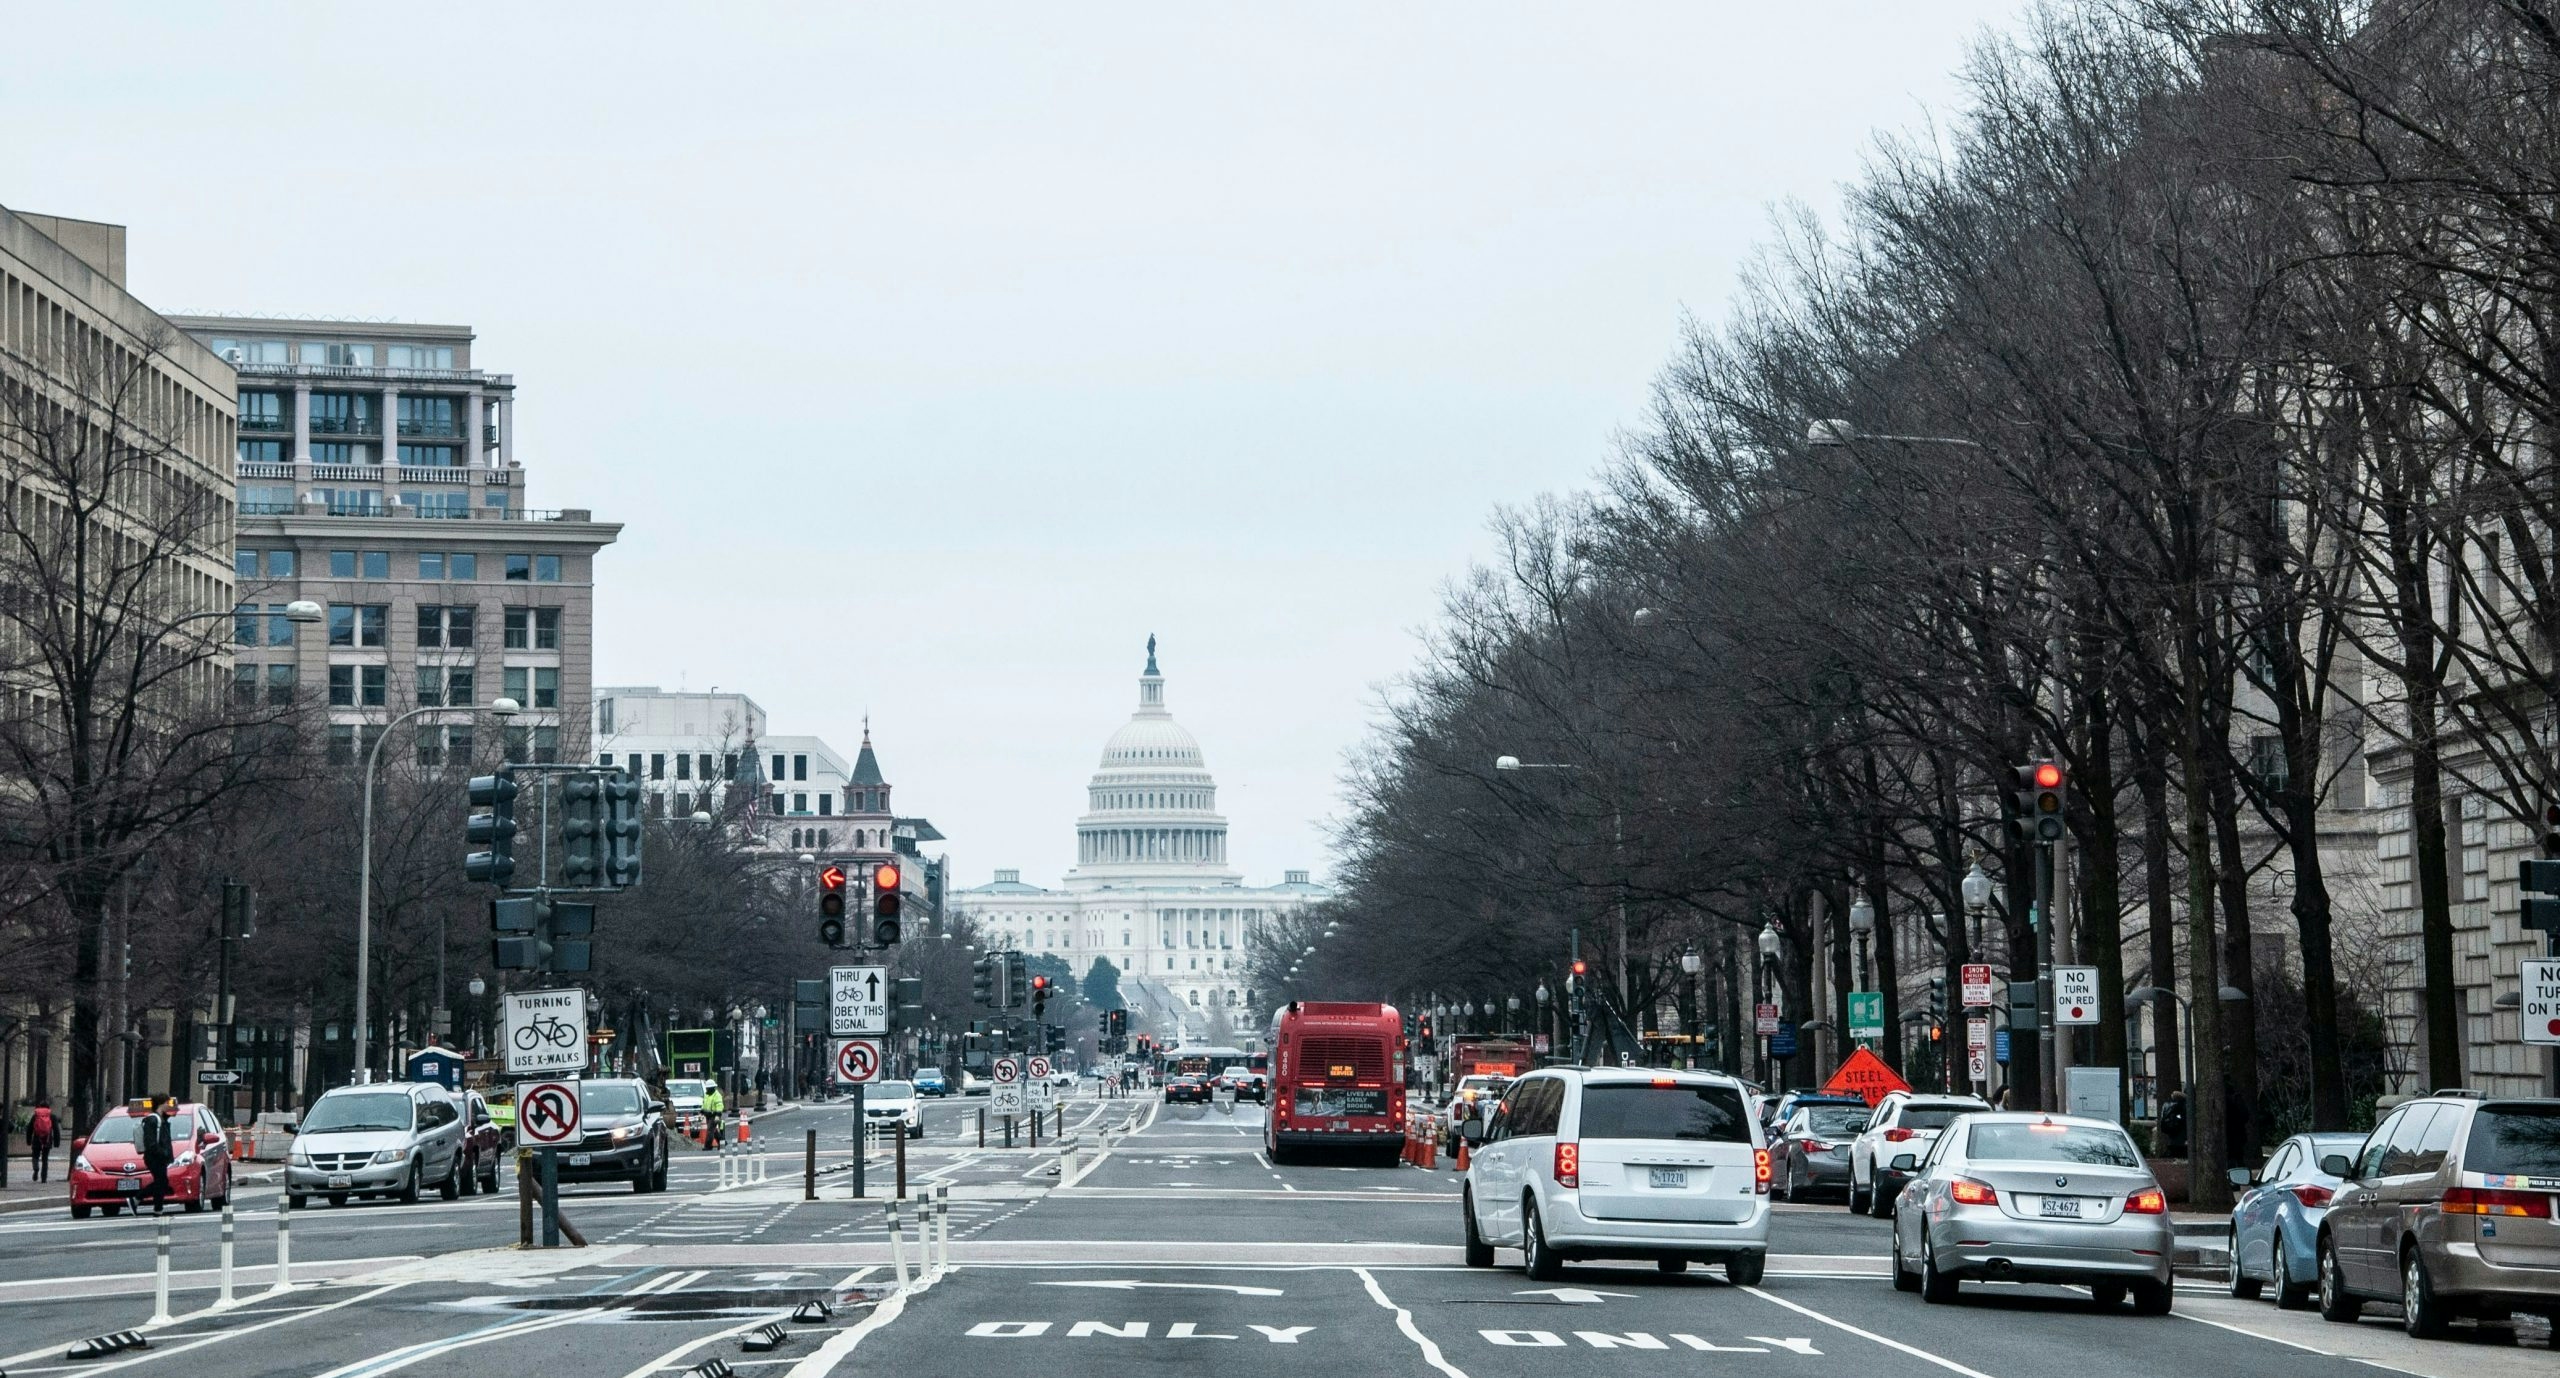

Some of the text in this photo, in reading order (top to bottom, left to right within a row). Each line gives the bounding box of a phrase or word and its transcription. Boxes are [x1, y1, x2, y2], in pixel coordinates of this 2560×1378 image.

[835, 971, 860, 982] THRU
[2066, 972, 2085, 983] NO
[2064, 985, 2089, 994] TURN
[518, 996, 571, 1009] TURNING
[2058, 996, 2095, 1005] ON RED
[834, 1005, 884, 1017] OBEY THIS
[2528, 1003, 2547, 1015] ON
[834, 1018, 869, 1030] SIGNAL
[515, 1052, 579, 1067] USE X-WALKS
[1845, 1070, 1883, 1084] STEEL
[964, 1321, 1317, 1343] ONLY
[1477, 1330, 1825, 1355] ONLY
